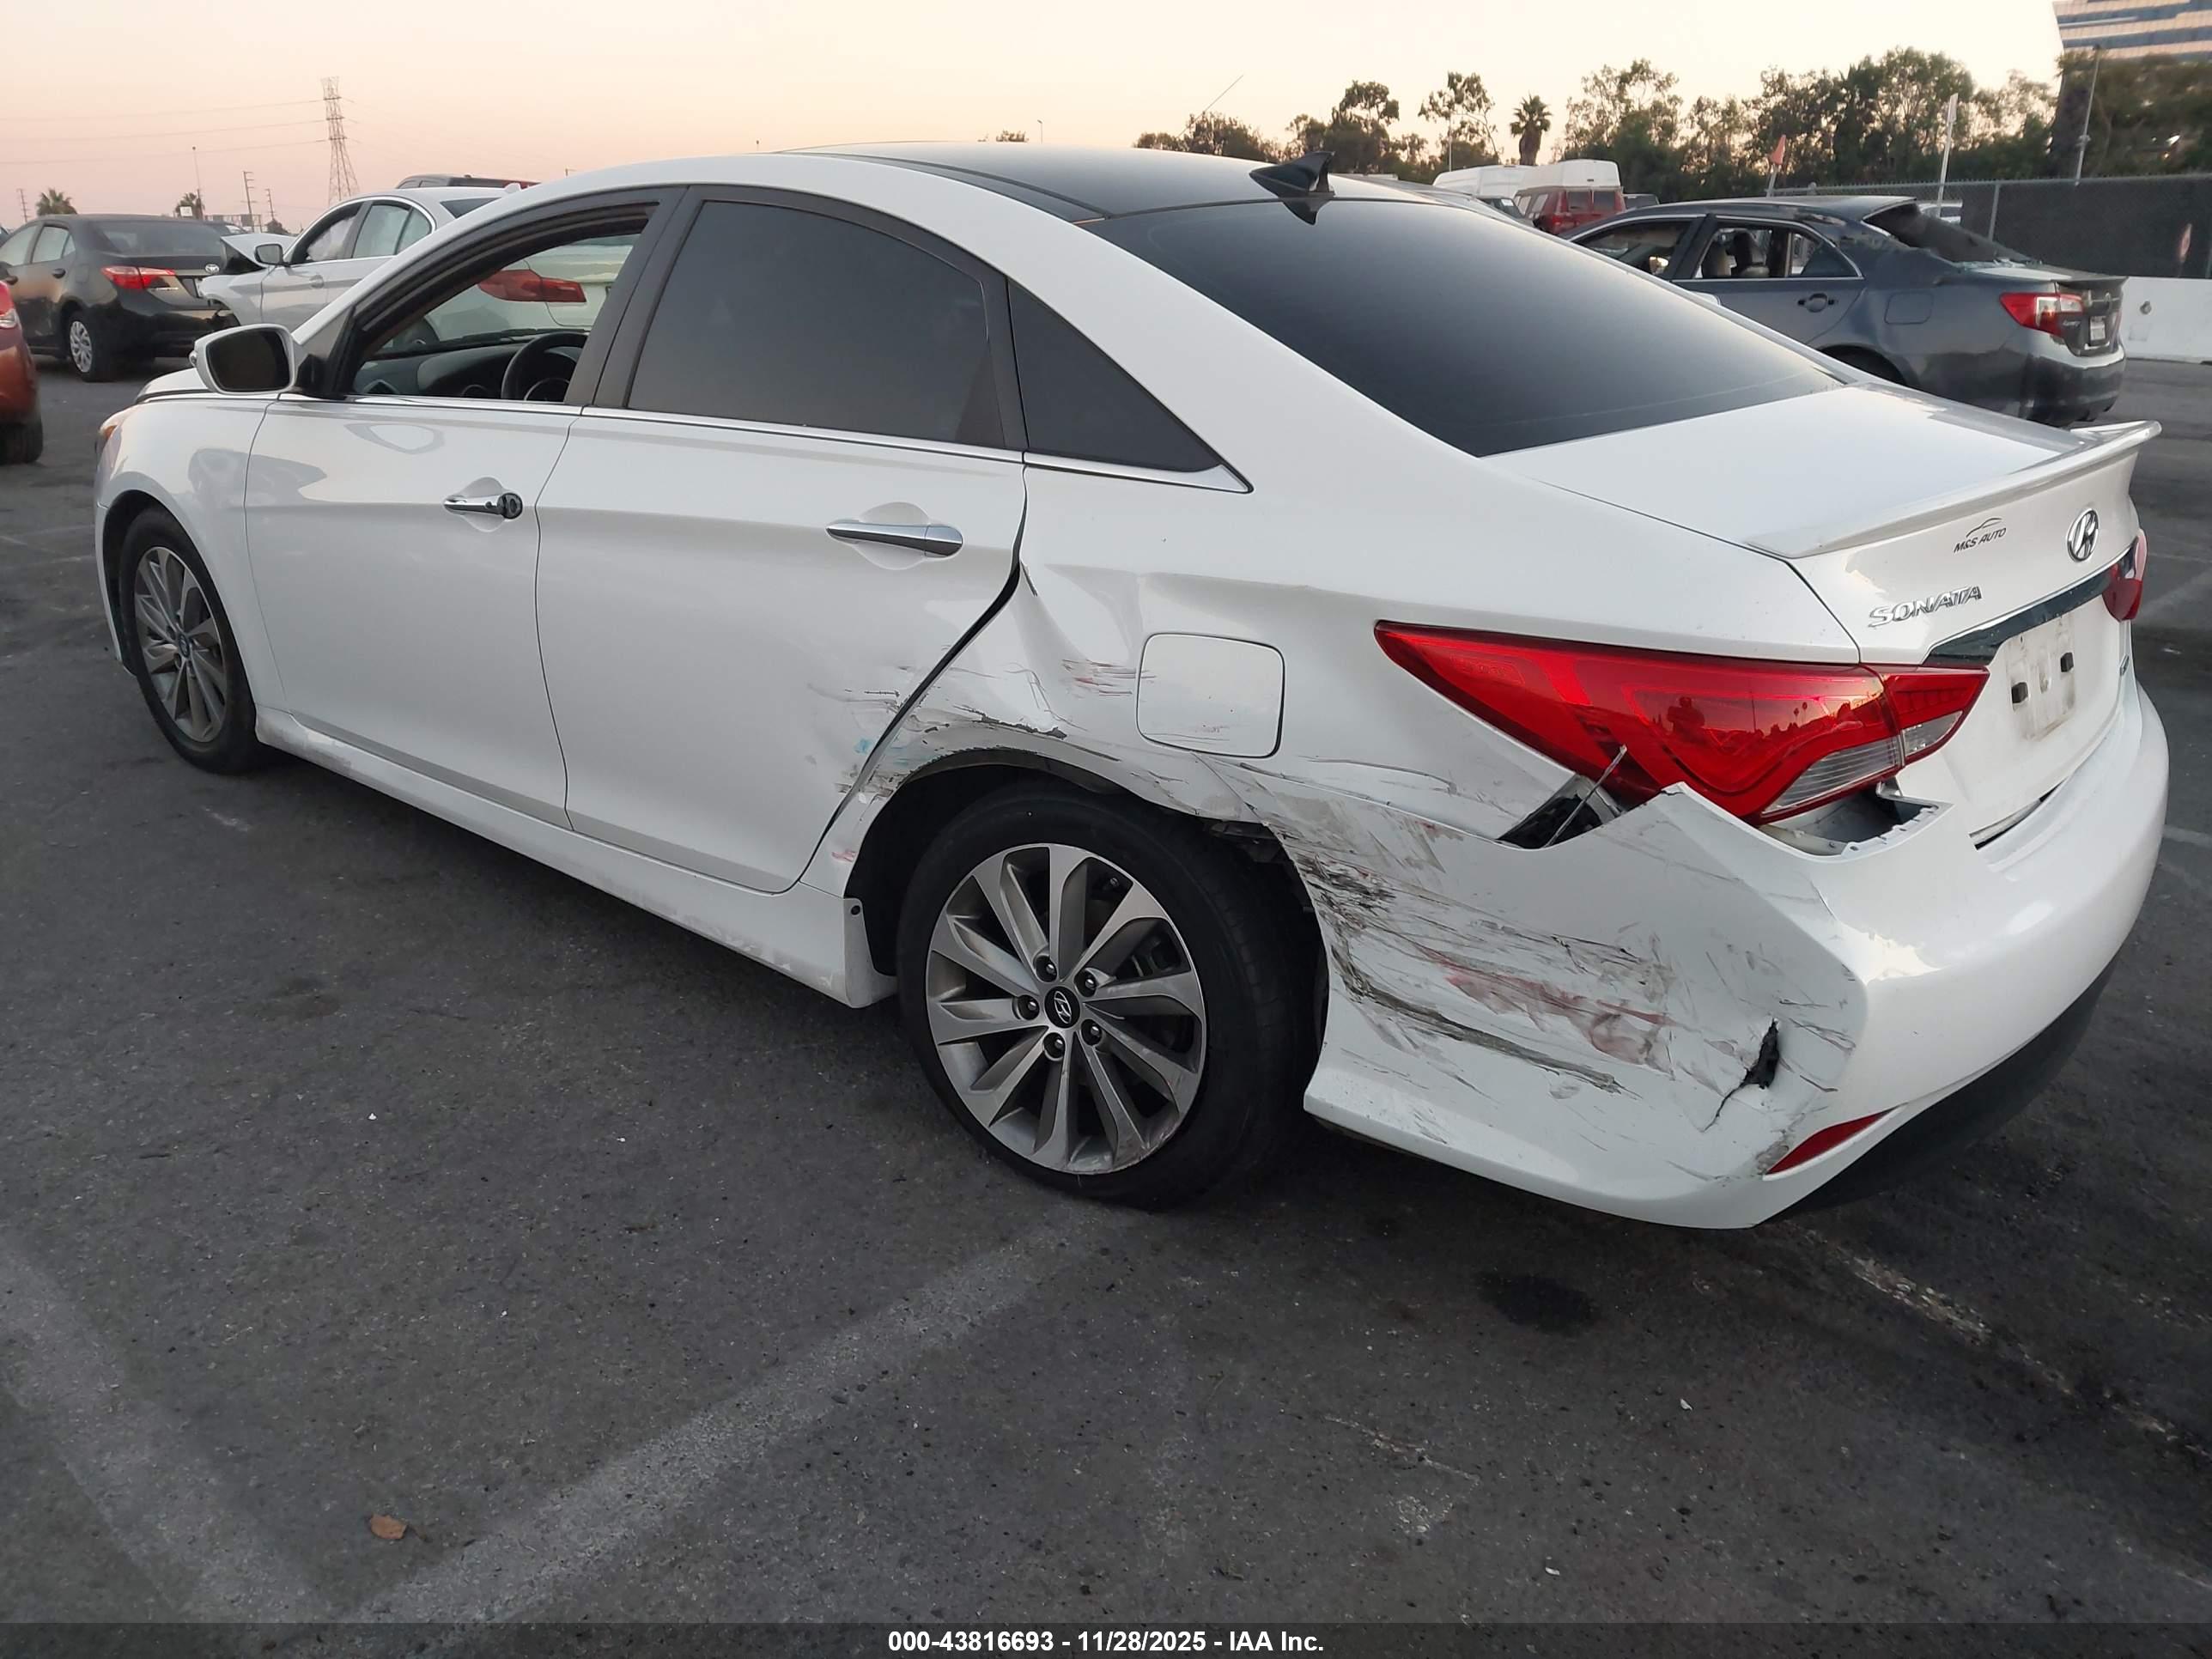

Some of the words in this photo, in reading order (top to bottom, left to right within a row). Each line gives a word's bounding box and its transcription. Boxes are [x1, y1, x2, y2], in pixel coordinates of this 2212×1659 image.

[1954, 537, 1978, 553] M&S
[1978, 527, 2007, 544] AUTO
[1869, 585, 1982, 628] SONATA
